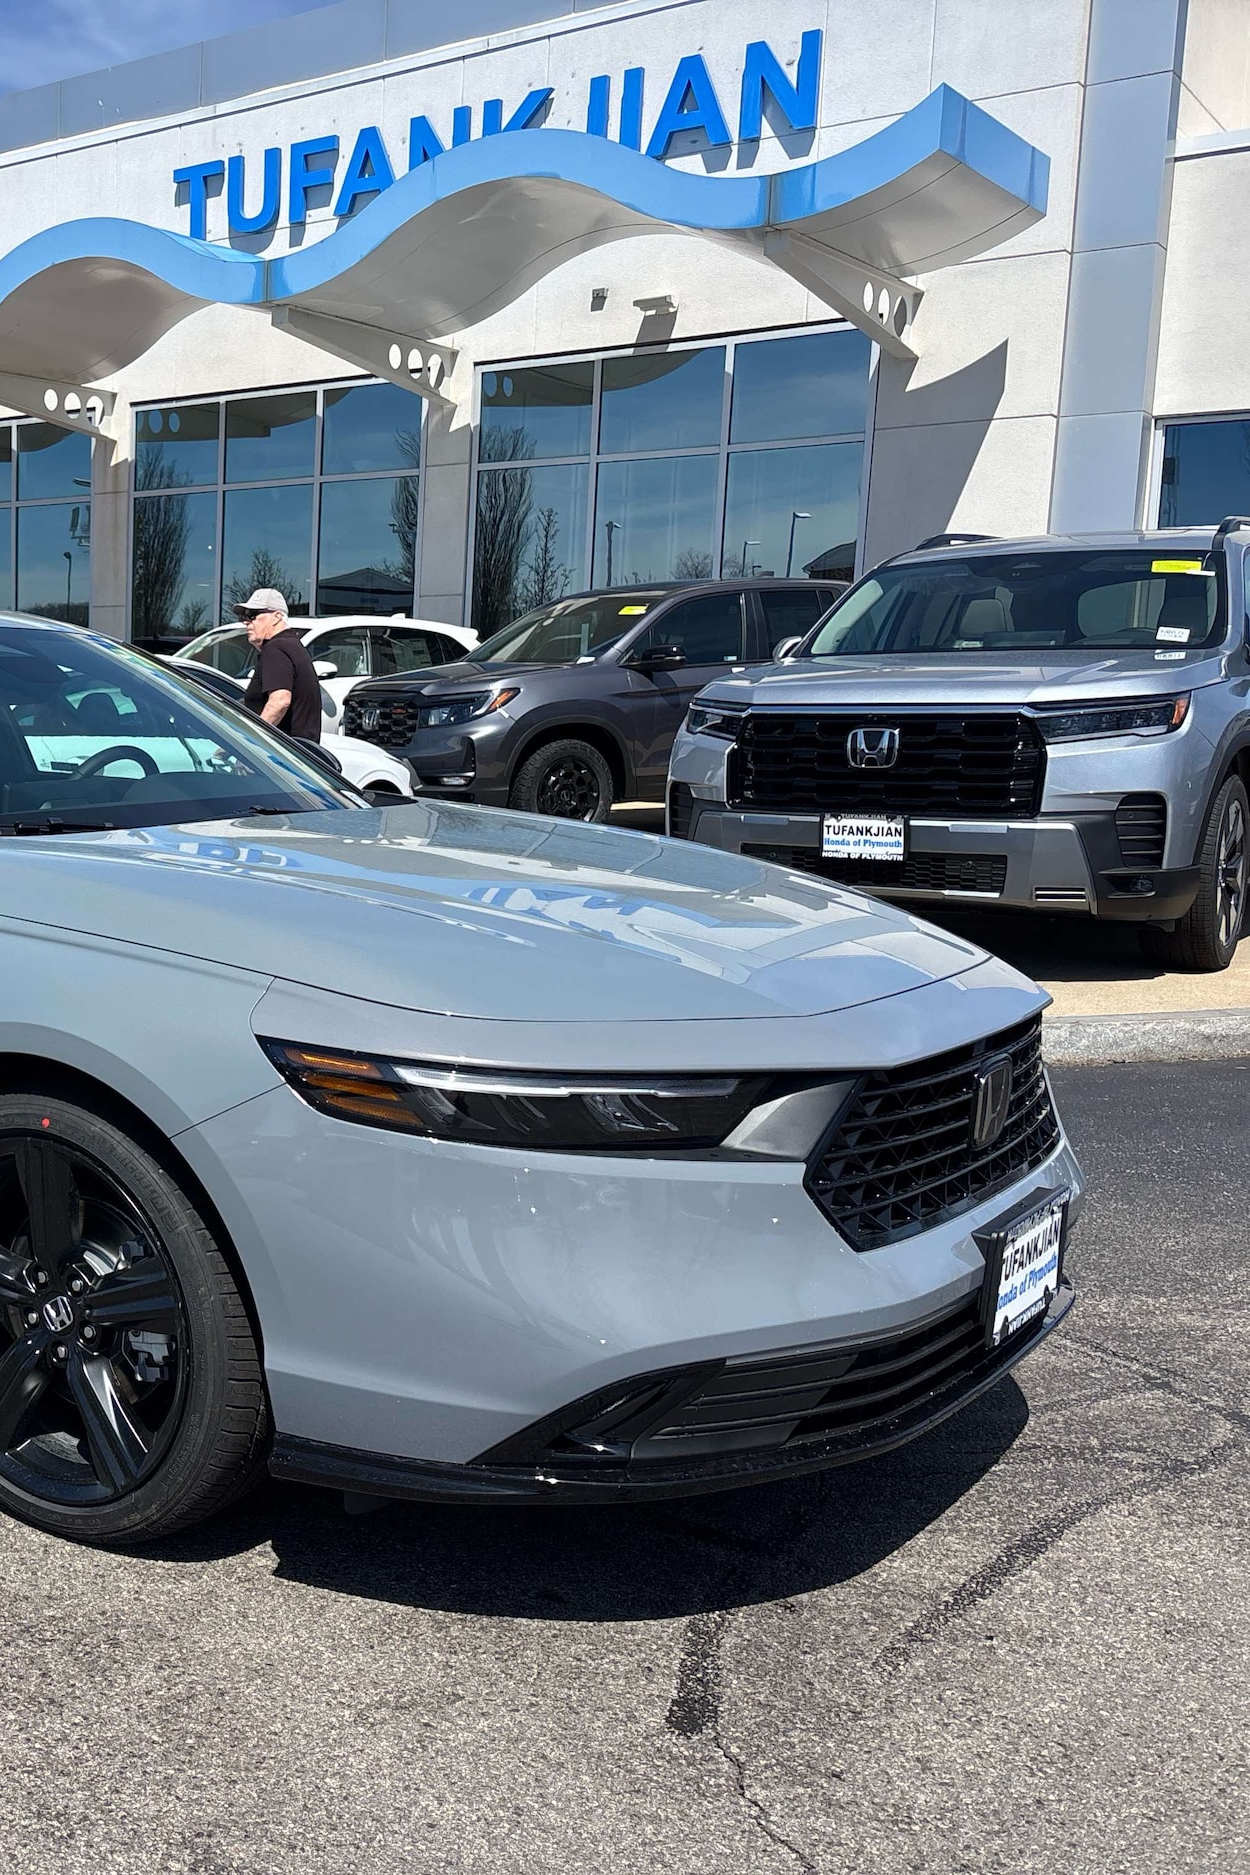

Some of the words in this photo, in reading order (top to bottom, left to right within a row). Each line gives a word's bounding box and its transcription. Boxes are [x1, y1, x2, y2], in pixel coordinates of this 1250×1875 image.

[824, 824, 903, 837] TUFANKJIAN
[824, 837, 851, 846] Honda
[852, 839, 861, 847] of
[862, 838, 903, 849] Plymouth
[1002, 1217, 1060, 1281] UFANKJIAN
[997, 1282, 1018, 1310] onda
[1019, 1273, 1030, 1296] of
[1028, 1251, 1058, 1289] Plymouth
